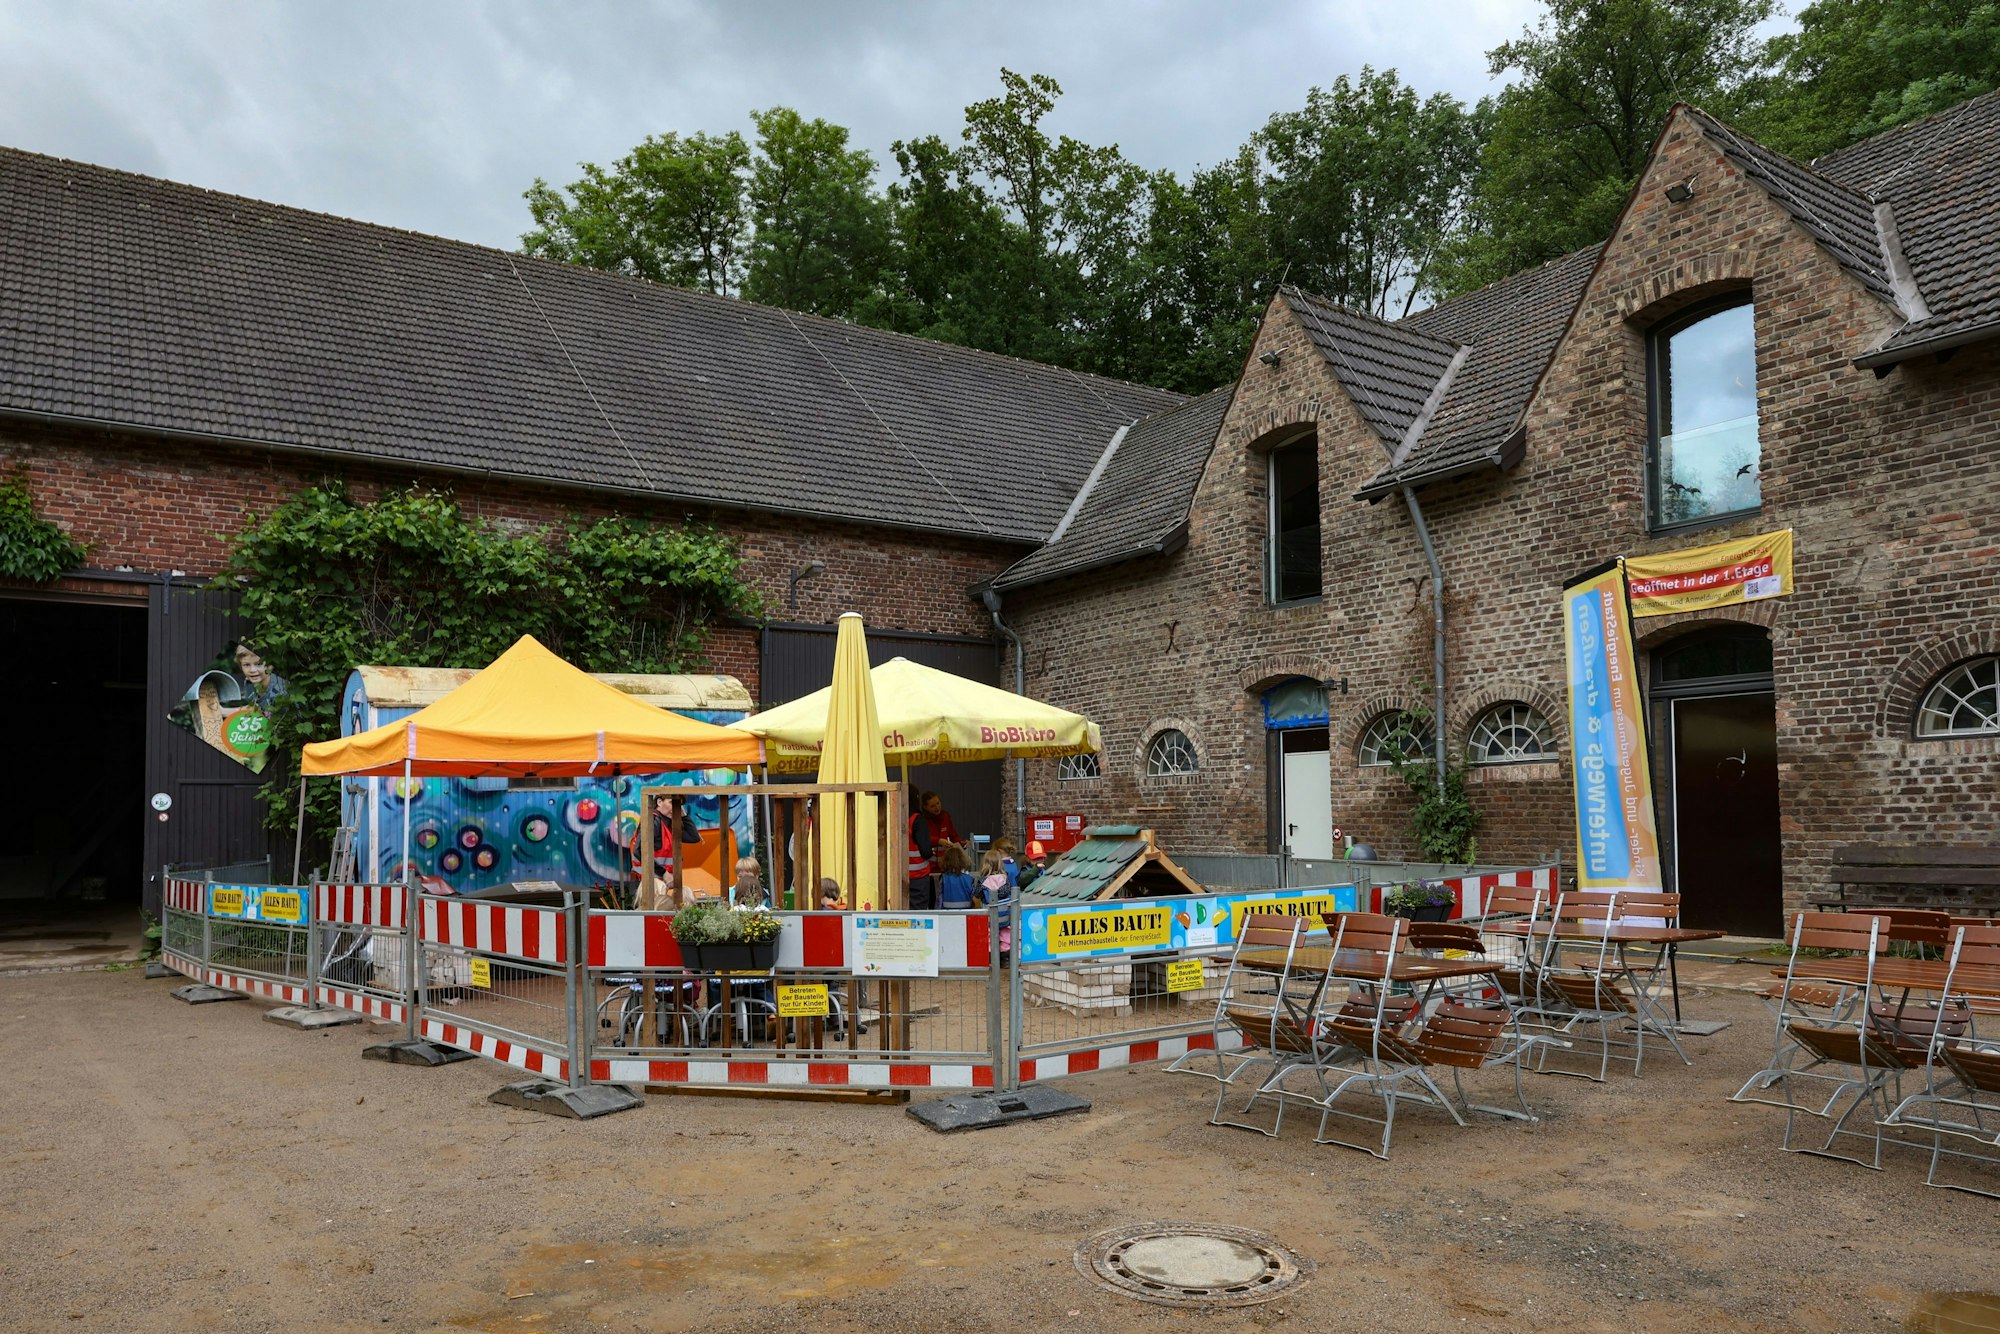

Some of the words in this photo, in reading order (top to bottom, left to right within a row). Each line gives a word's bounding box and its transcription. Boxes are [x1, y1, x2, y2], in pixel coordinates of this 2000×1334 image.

[1720, 547, 1771, 562] EnergieStadt
[1630, 578, 1680, 594] Geöffnet
[1683, 576, 1695, 588] in
[1699, 573, 1719, 585] der
[1723, 562, 1769, 581] 1.Etage
[1632, 599, 1668, 610] Information
[1670, 598, 1683, 606] und
[1685, 592, 1722, 605] Anmeldung
[1723, 588, 1744, 598] unter
[237, 716, 263, 732] 35
[905, 737, 937, 747] natürlich
[980, 726, 1056, 744] BioBistro
[215, 892, 227, 903] ALLES
[227, 893, 242, 905] BAUT!
[265, 896, 280, 907] ALLES
[281, 897, 298, 909] BAUT!
[1288, 900, 1327, 917] BAUT!
[1058, 917, 1108, 936] ALLES
[1113, 913, 1162, 932] BAUT!
[1057, 940, 1067, 948] Die
[1068, 936, 1118, 947] Mitmachbaustelle
[1119, 935, 1128, 943] der
[1129, 932, 1162, 943] EnergieStadt
